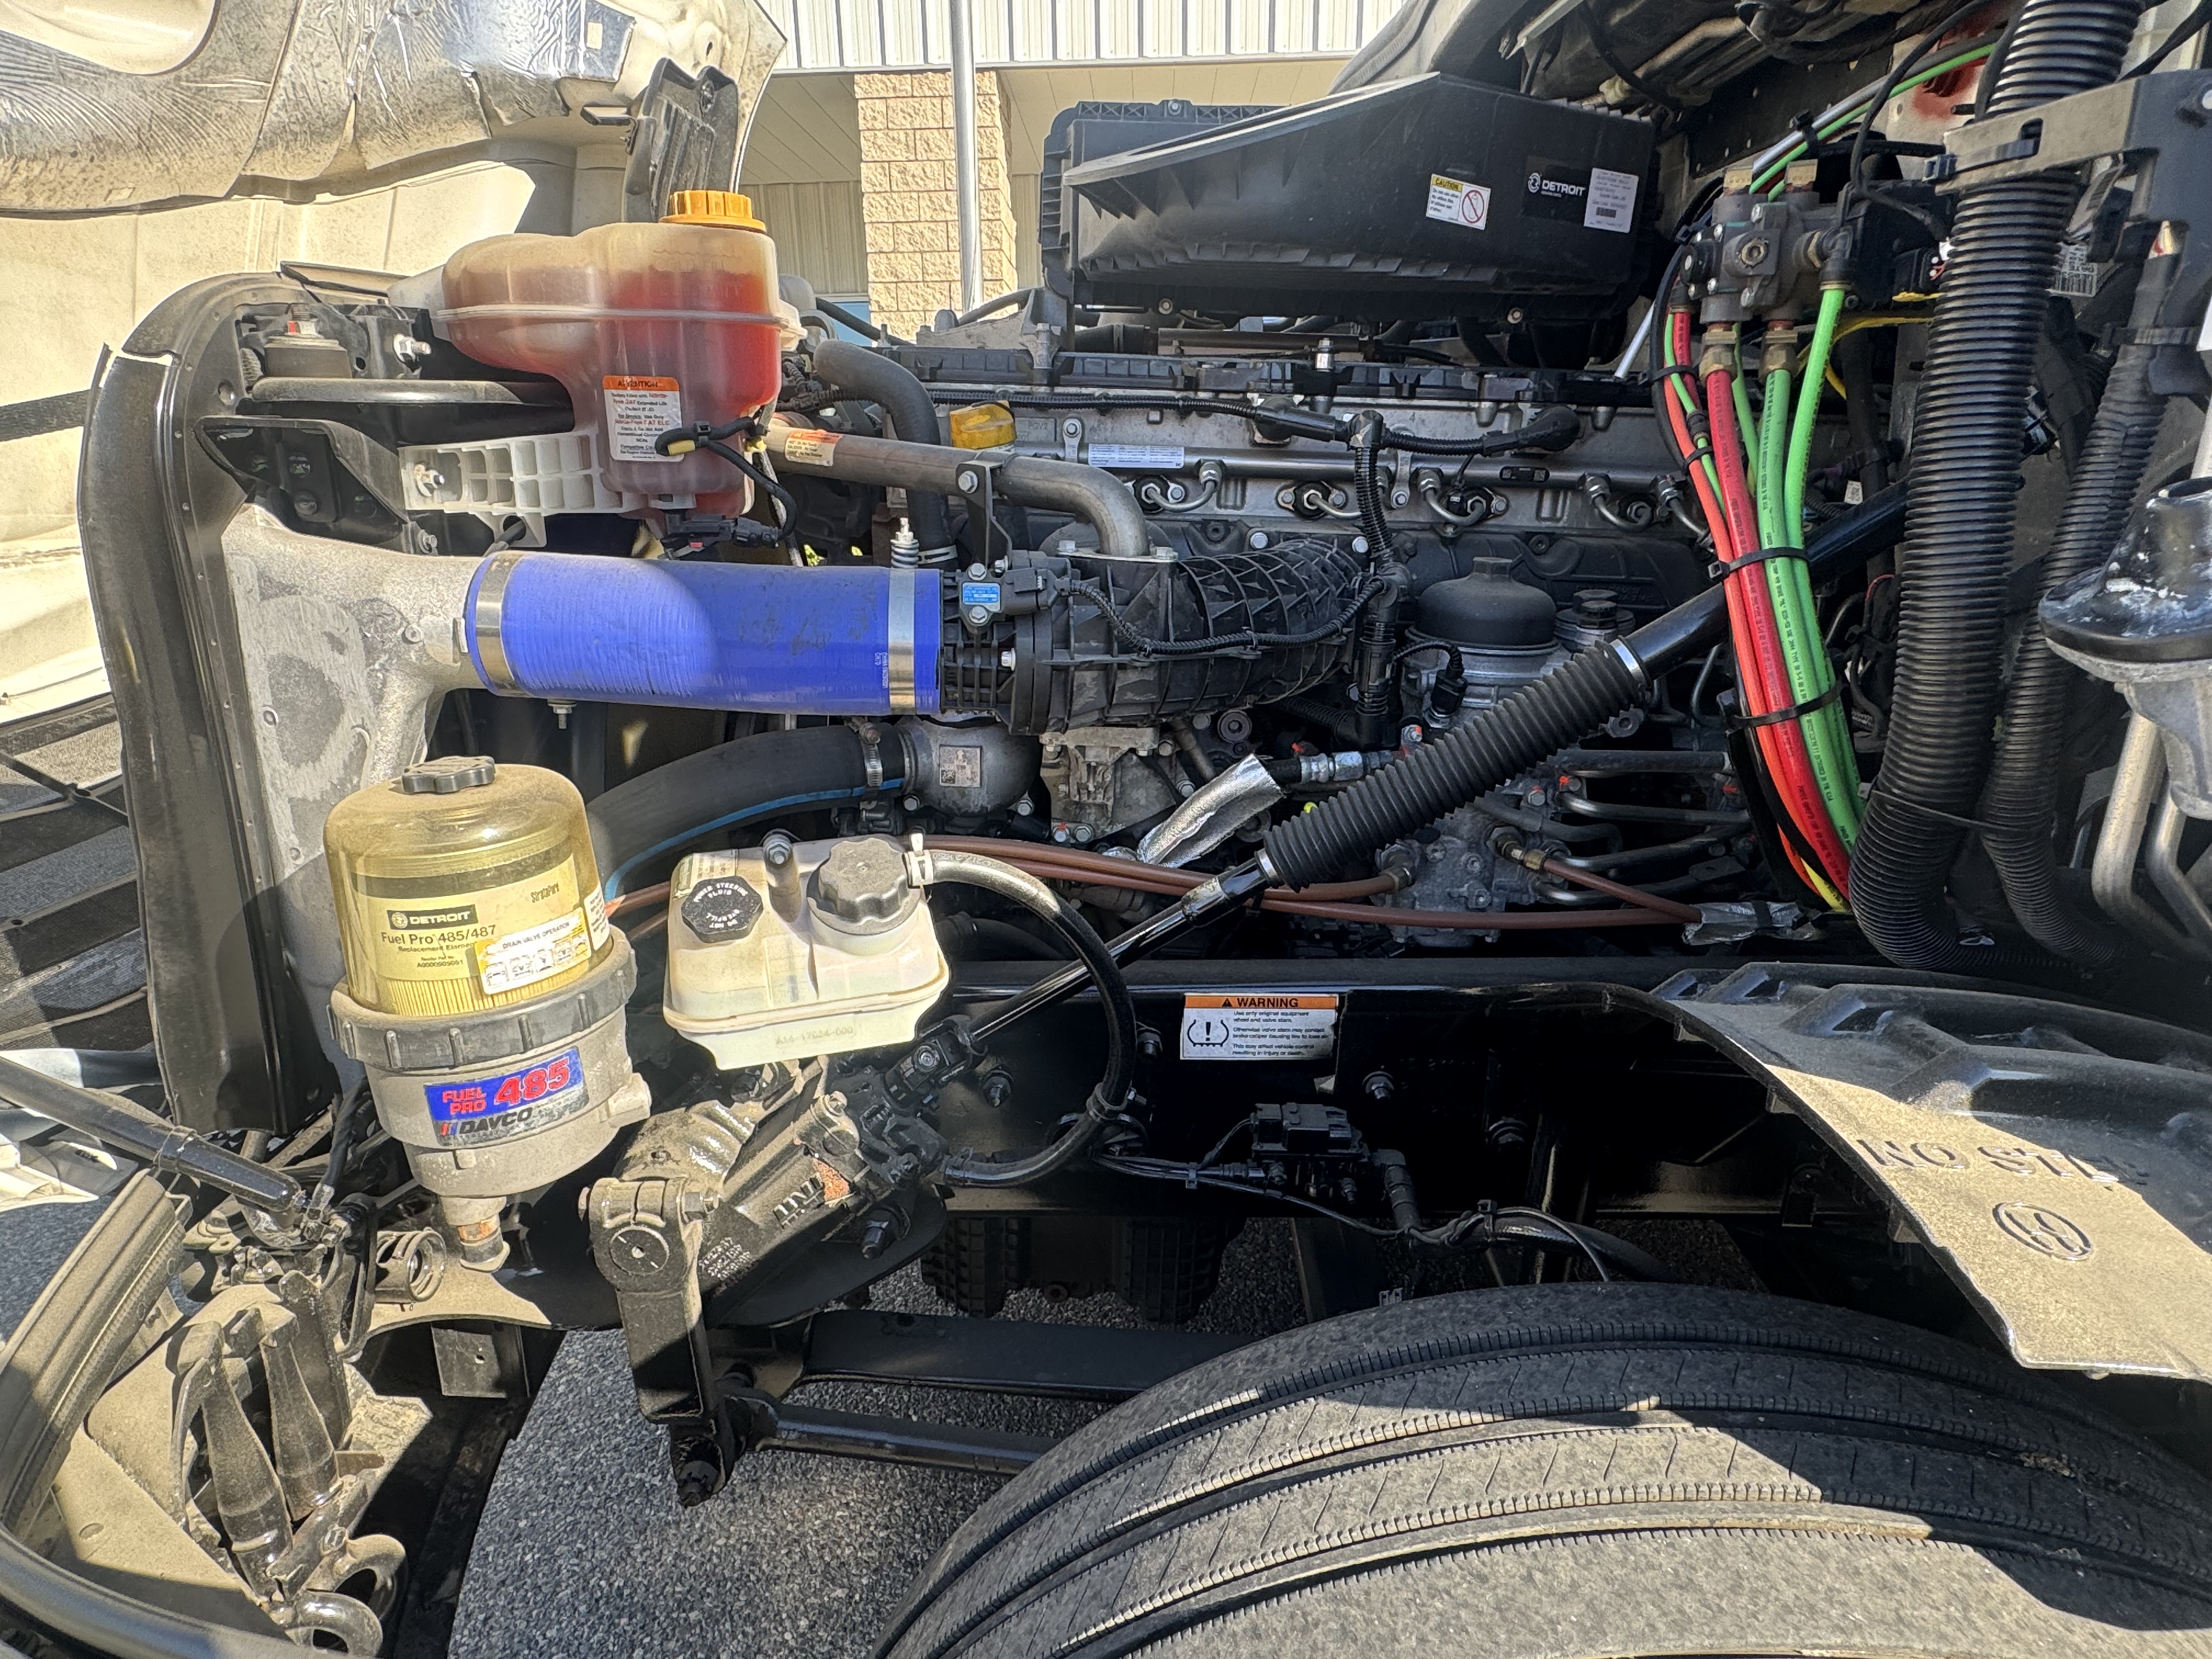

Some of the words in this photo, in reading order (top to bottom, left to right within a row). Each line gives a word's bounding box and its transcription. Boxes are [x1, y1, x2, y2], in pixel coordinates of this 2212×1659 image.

[1436, 178, 1459, 190] CAUTION
[1542, 180, 1585, 196] DETROIT
[1409, 412, 1415, 422] 4
[410, 911, 471, 924] DETROIT
[381, 932, 405, 945] Fuel
[409, 934, 433, 945] Pro
[438, 924, 496, 943] 485/487
[502, 940, 522, 949] DRAIN
[523, 933, 541, 943] VALVE
[542, 922, 570, 936] OPERATION
[446, 943, 476, 951] Elemen
[1237, 997, 1299, 1007] WARNING
[442, 1087, 487, 1104] FUEL
[494, 1057, 569, 1107] 485
[450, 1099, 487, 1115] PRO
[459, 1107, 533, 1135] DAVCO
[1857, 1139, 1968, 1170] NO
